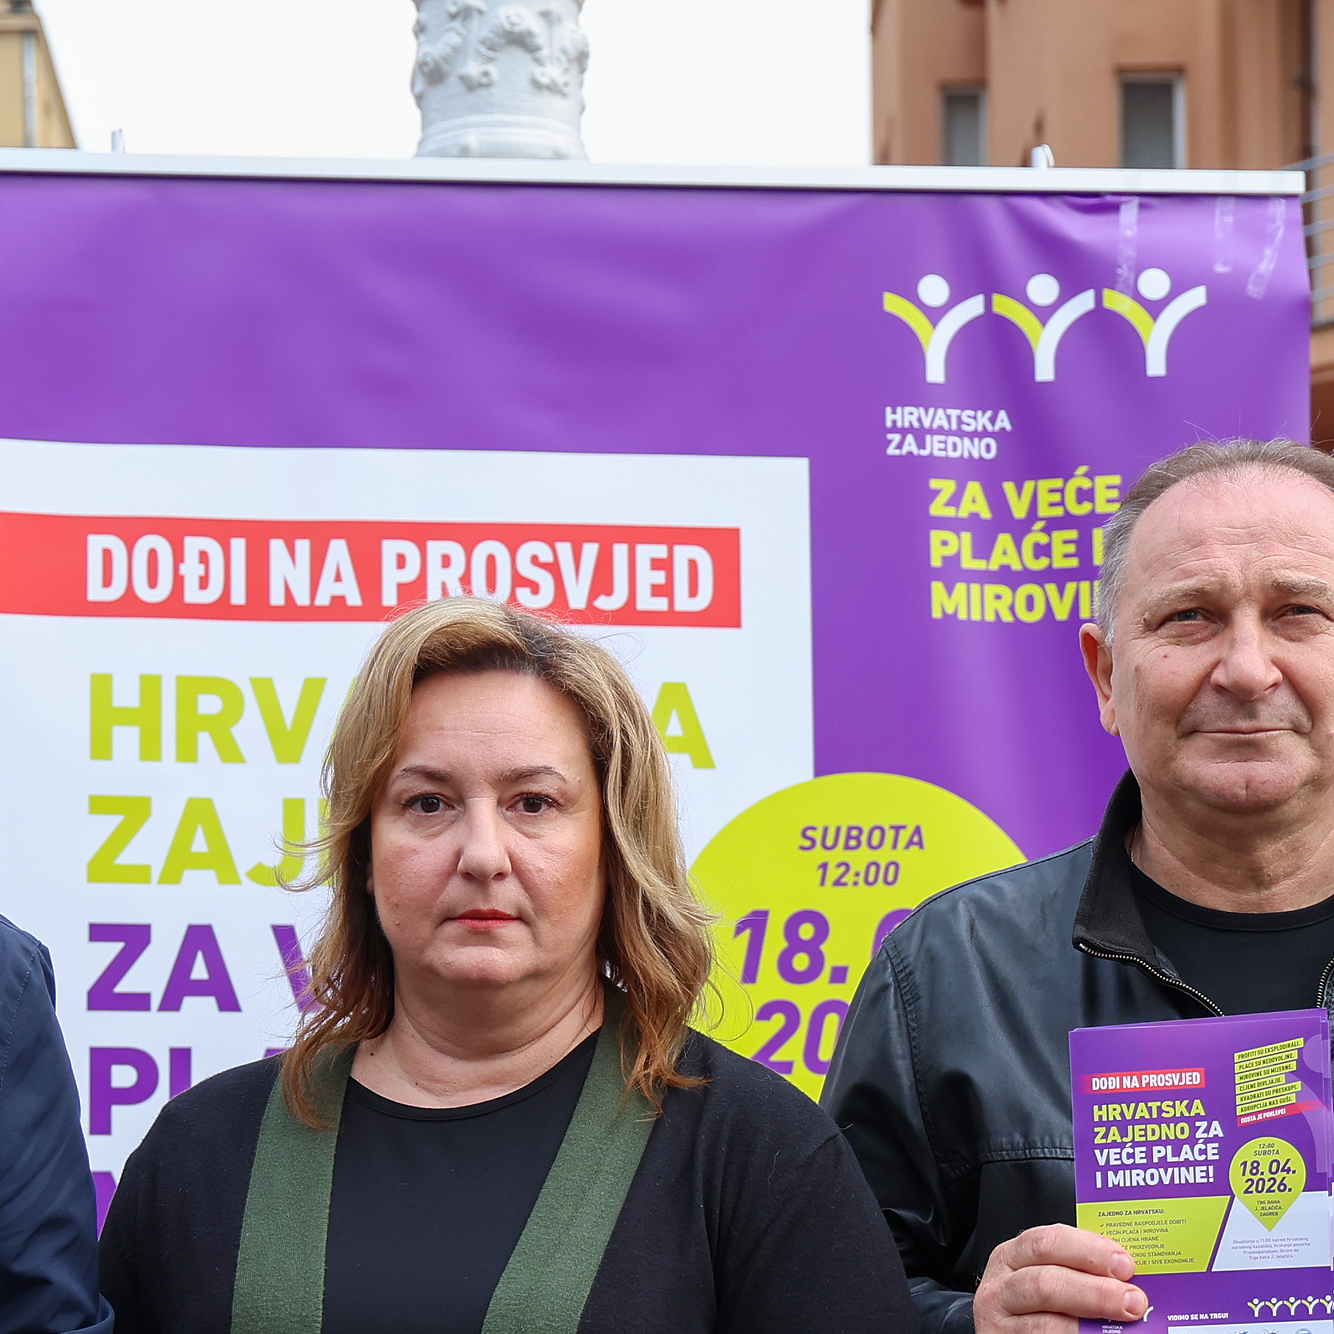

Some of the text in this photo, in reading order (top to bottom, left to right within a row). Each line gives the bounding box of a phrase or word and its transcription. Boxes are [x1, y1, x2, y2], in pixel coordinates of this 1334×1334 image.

[884, 406, 1012, 433] HRVATSKA
[885, 433, 998, 461] ZAJEDNO
[929, 465, 1121, 519] ZA VEĆE
[929, 521, 1078, 571] PLAĆE
[87, 533, 714, 613] DOĐI NA PROSVJED
[930, 580, 1098, 623] MIROVI
[797, 824, 925, 851] SUBOTA
[815, 861, 901, 887] 12:00
[733, 908, 850, 985] 18.
[87, 922, 242, 1012] ZA
[1092, 1071, 1201, 1090] DOĐI NA PROSVJED
[1094, 1099, 1205, 1121] HRVATSKA
[1241, 1115, 1256, 1123] DOSTA
[1263, 1108, 1286, 1118] POHLEPE!
[1094, 1121, 1224, 1143] ZAJEDNO ZA
[1094, 1139, 1219, 1166] VEĆE PLAĆE
[1096, 1166, 1214, 1188] I MIROVINE!
[1239, 1159, 1297, 1177] 18. 04.
[1243, 1176, 1293, 1194] 2026.
